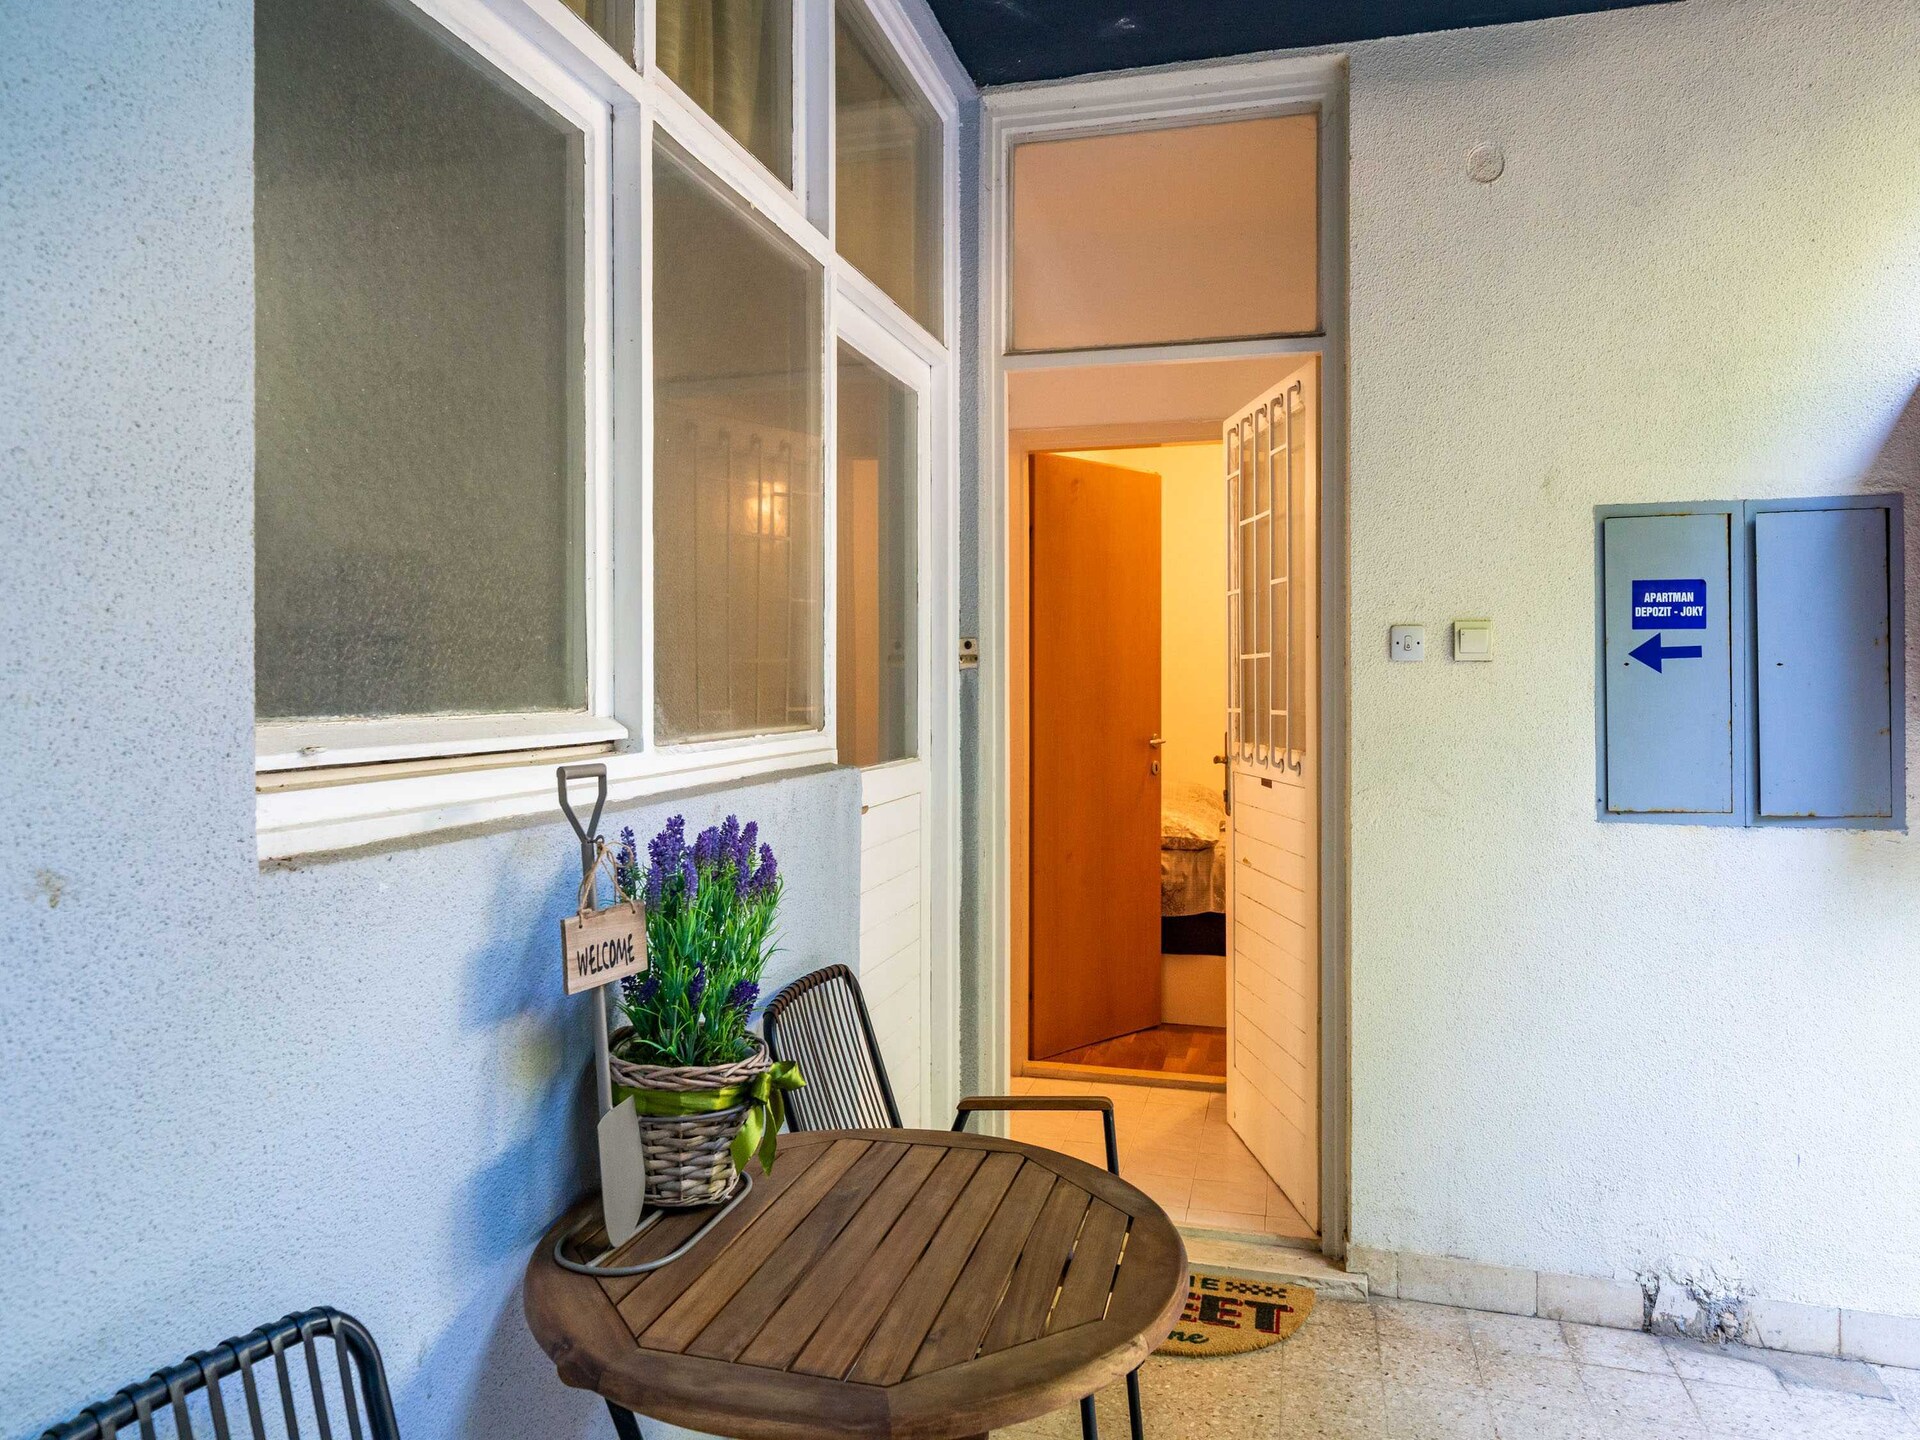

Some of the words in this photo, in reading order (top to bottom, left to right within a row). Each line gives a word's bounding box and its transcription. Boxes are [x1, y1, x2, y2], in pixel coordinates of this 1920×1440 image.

[1644, 592, 1694, 602] APARTMAN
[1635, 607, 1672, 617] DEPOZIT
[1680, 606, 1704, 617] JOKY
[576, 933, 635, 976] WELCOME
